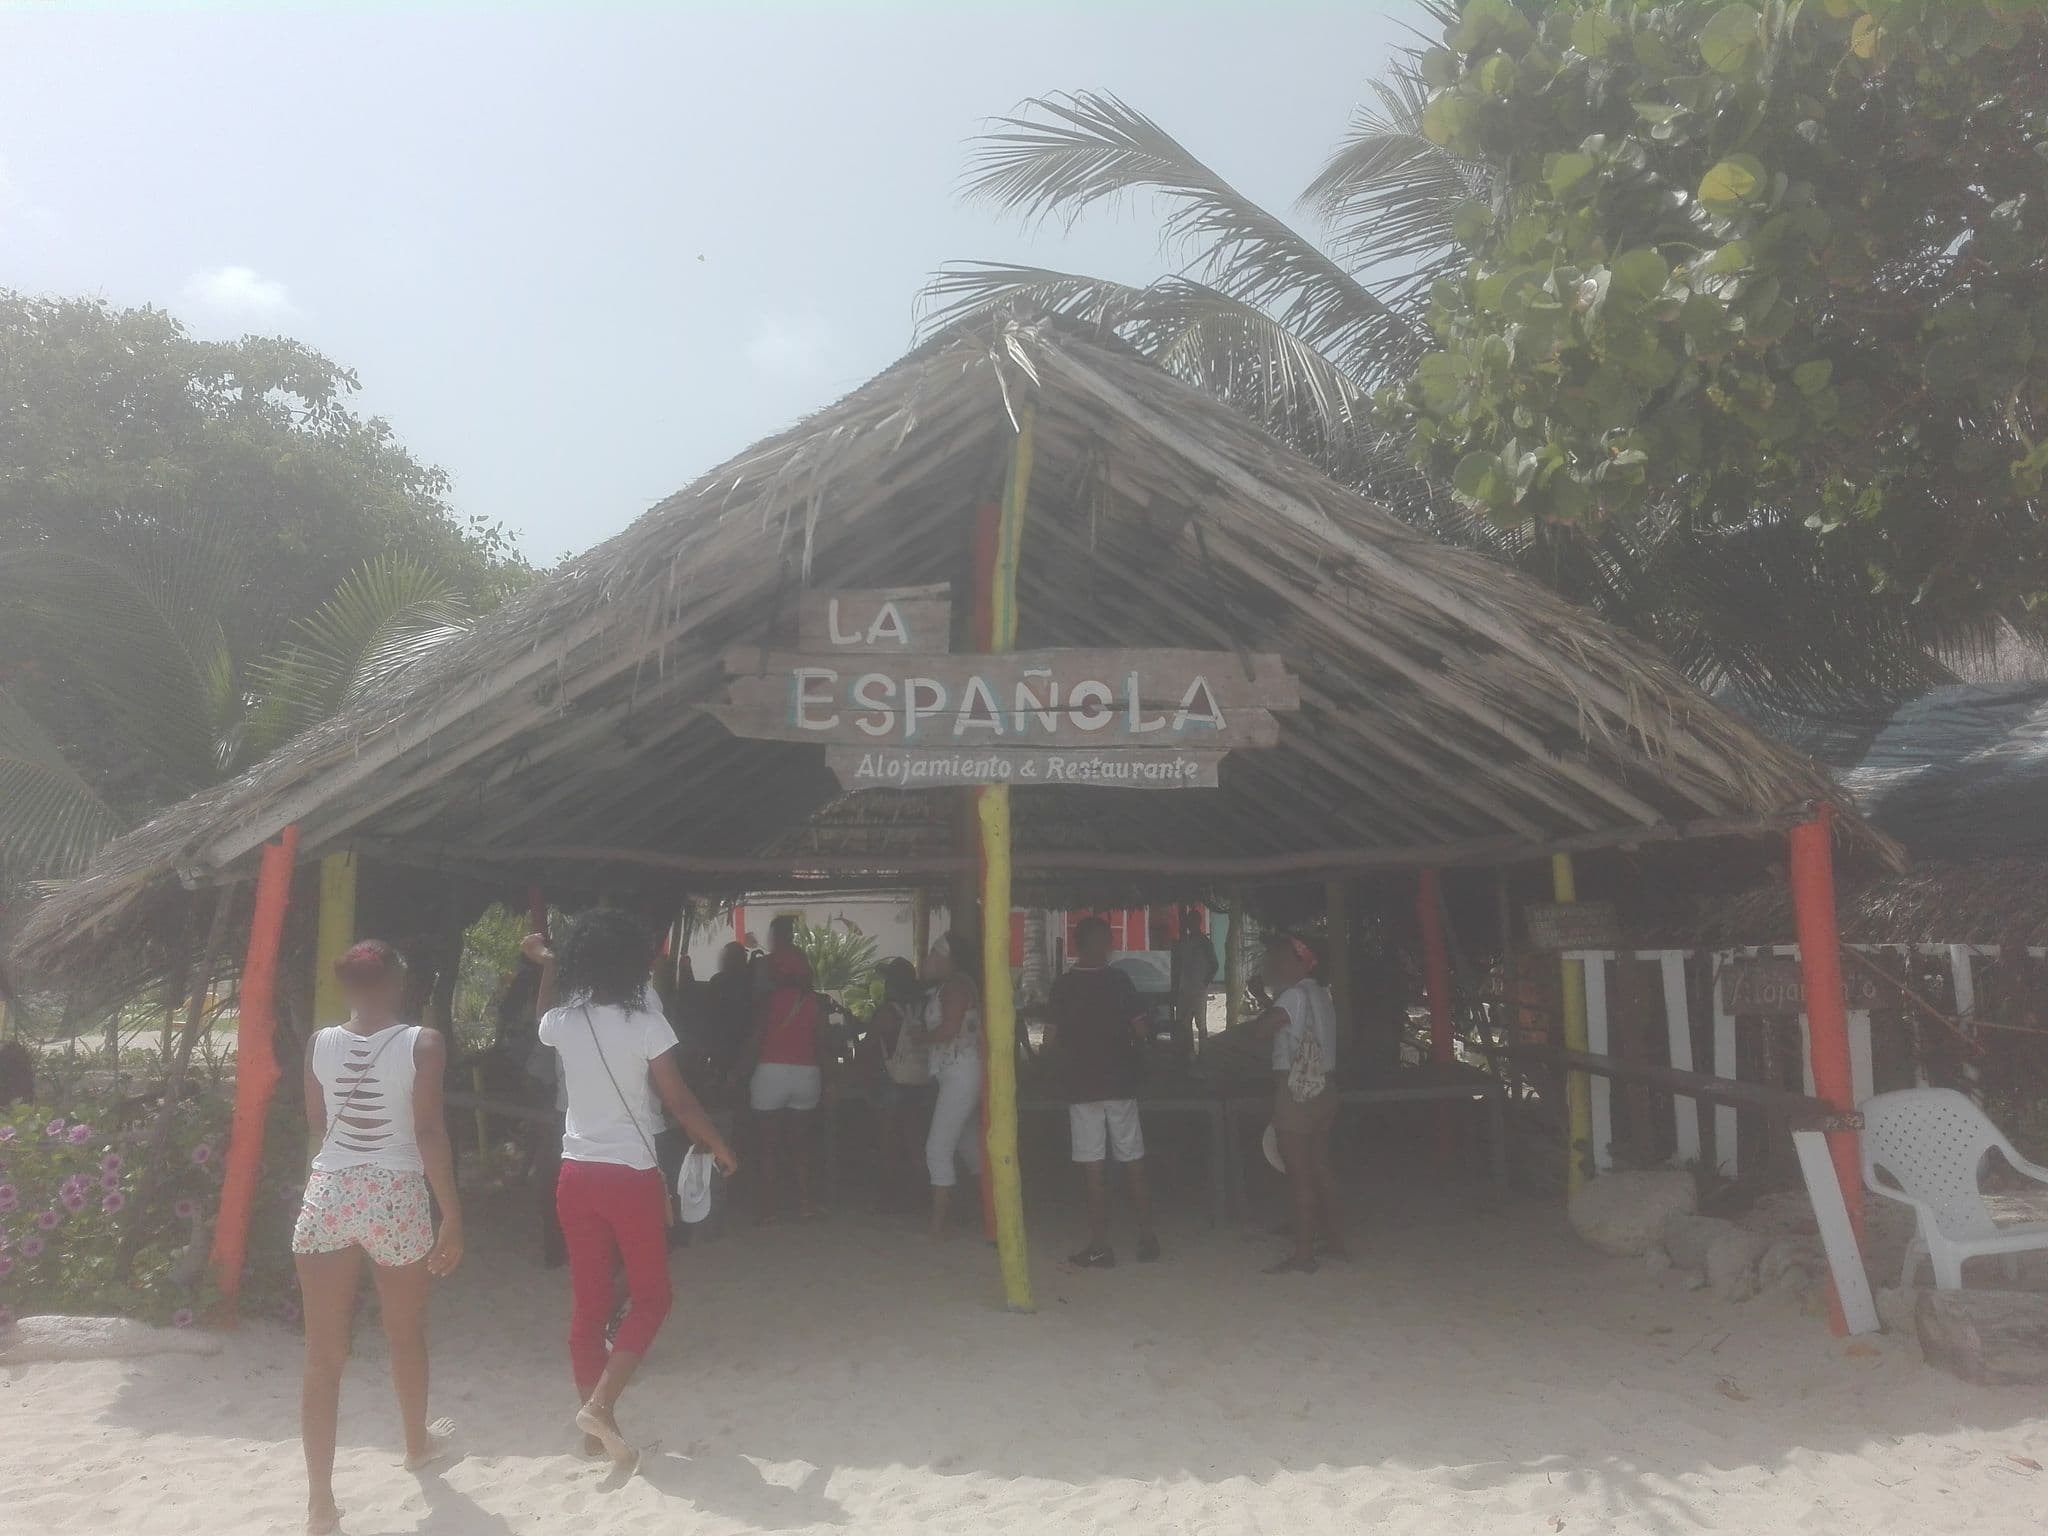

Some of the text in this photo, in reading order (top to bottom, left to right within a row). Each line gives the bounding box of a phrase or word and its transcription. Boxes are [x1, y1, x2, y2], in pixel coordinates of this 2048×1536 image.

[828, 599, 908, 645] LA
[792, 666, 1228, 737] ESPAÑOLA
[854, 753, 1199, 785] Alojamiento & Restaurante
